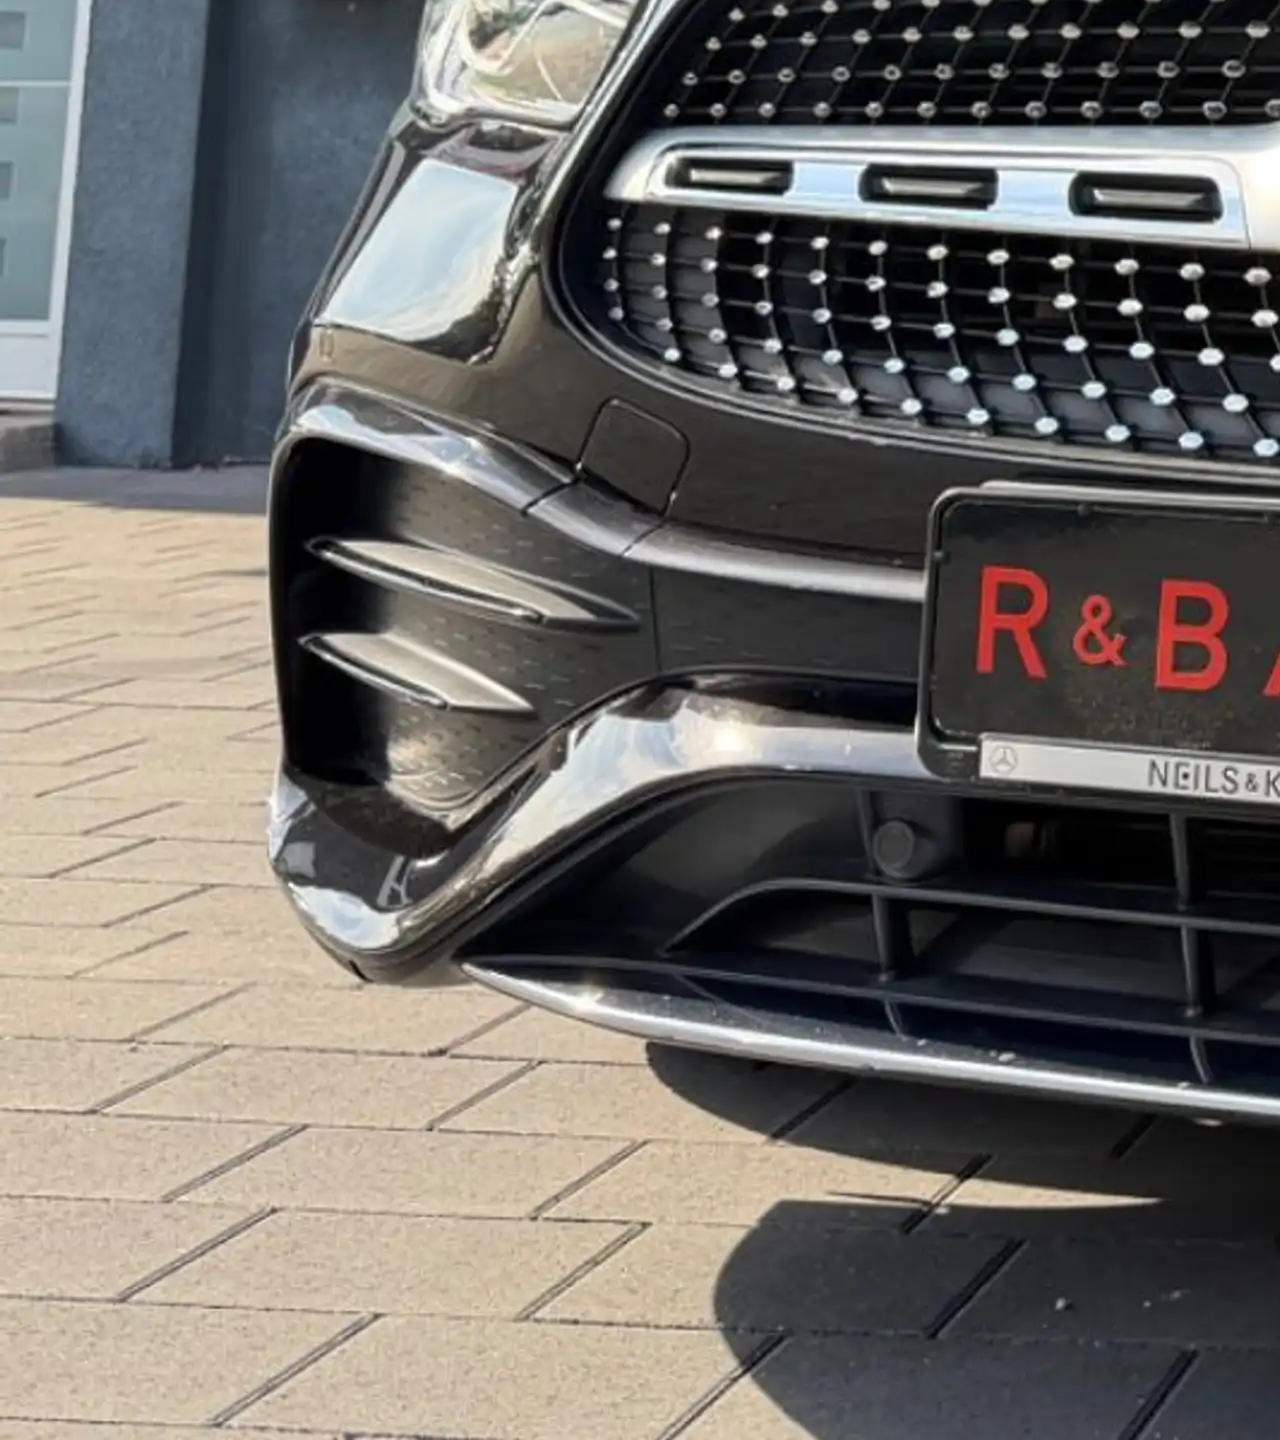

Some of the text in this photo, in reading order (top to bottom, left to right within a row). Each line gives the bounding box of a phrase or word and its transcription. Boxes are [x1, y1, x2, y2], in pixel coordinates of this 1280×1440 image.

[977, 566, 1048, 679] R
[1073, 594, 1126, 667] &
[1154, 580, 1230, 692] B
